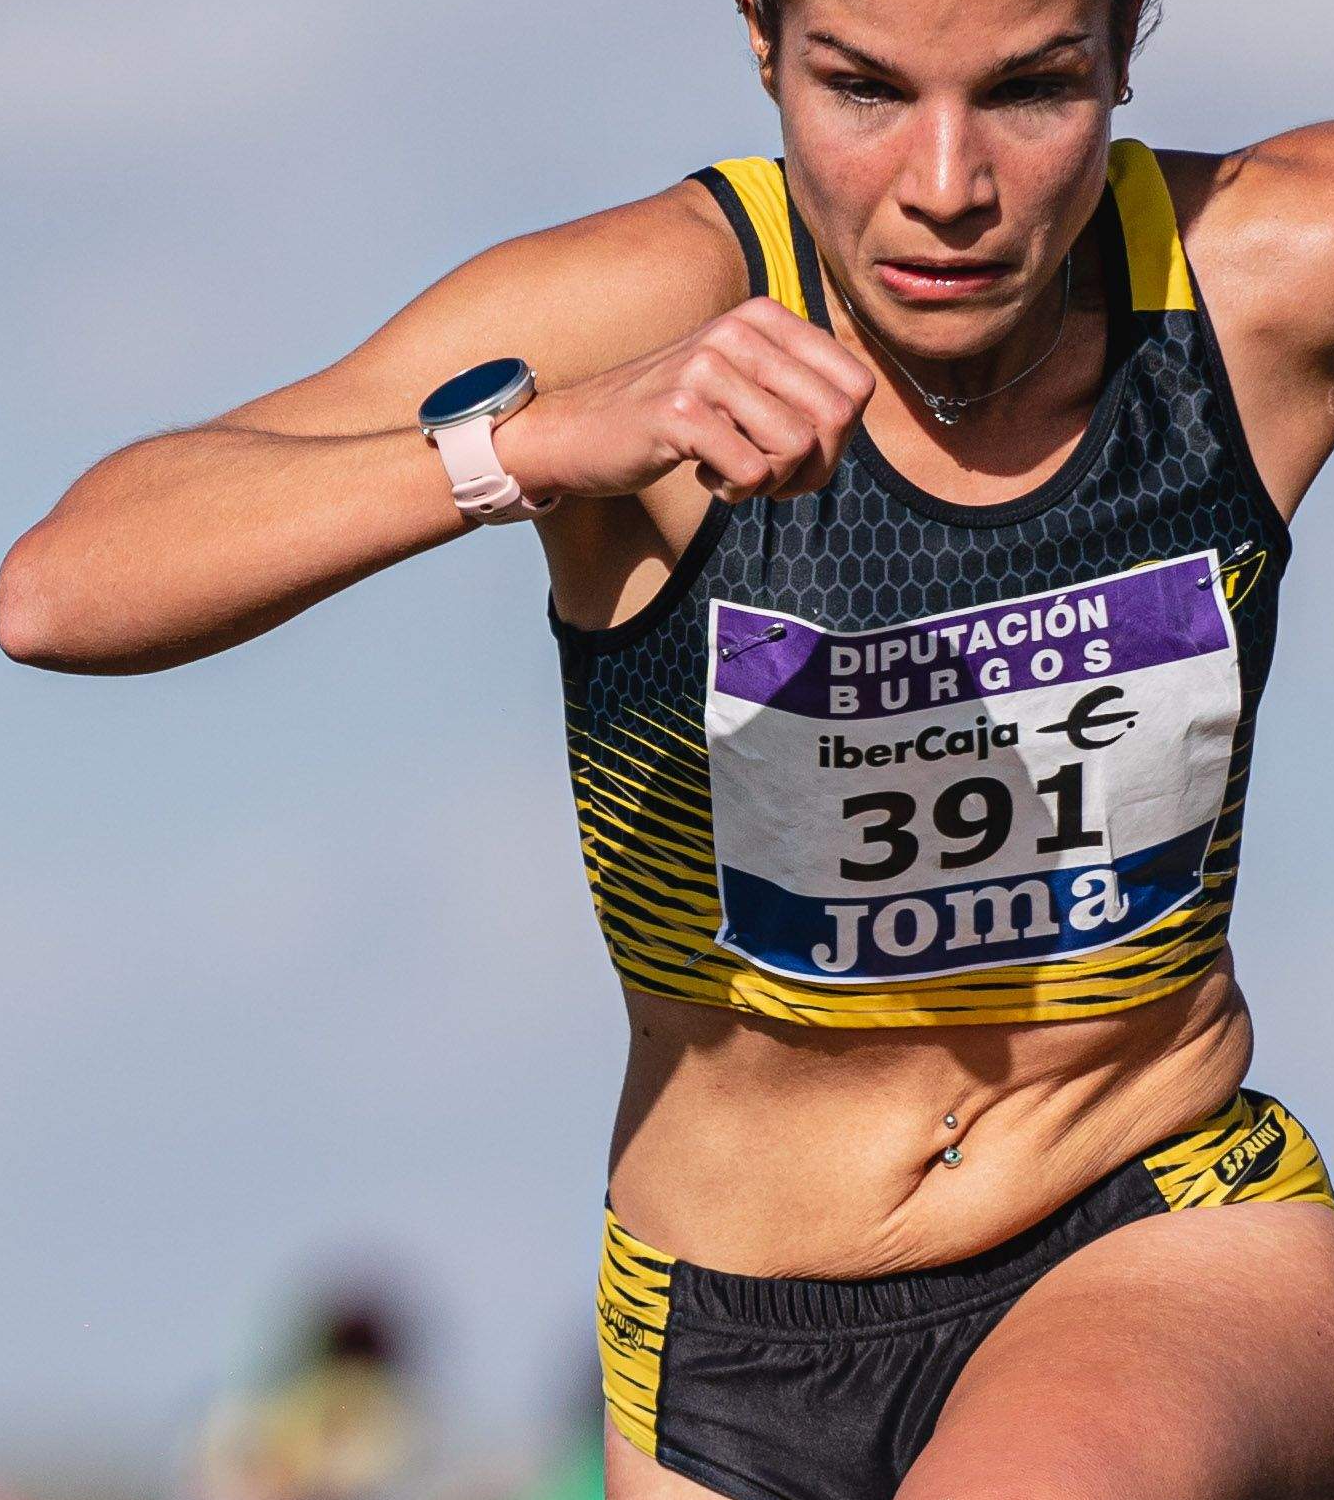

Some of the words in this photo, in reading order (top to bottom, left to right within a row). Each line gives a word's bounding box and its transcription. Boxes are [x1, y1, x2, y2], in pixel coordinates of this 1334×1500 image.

[829, 594, 1109, 677] DIPUTACIÓN
[829, 638, 1112, 715] BURGOS
[818, 714, 1020, 770] iberCaja
[839, 761, 1103, 883] 391
[1221, 1122, 1281, 1180] SPRINT
